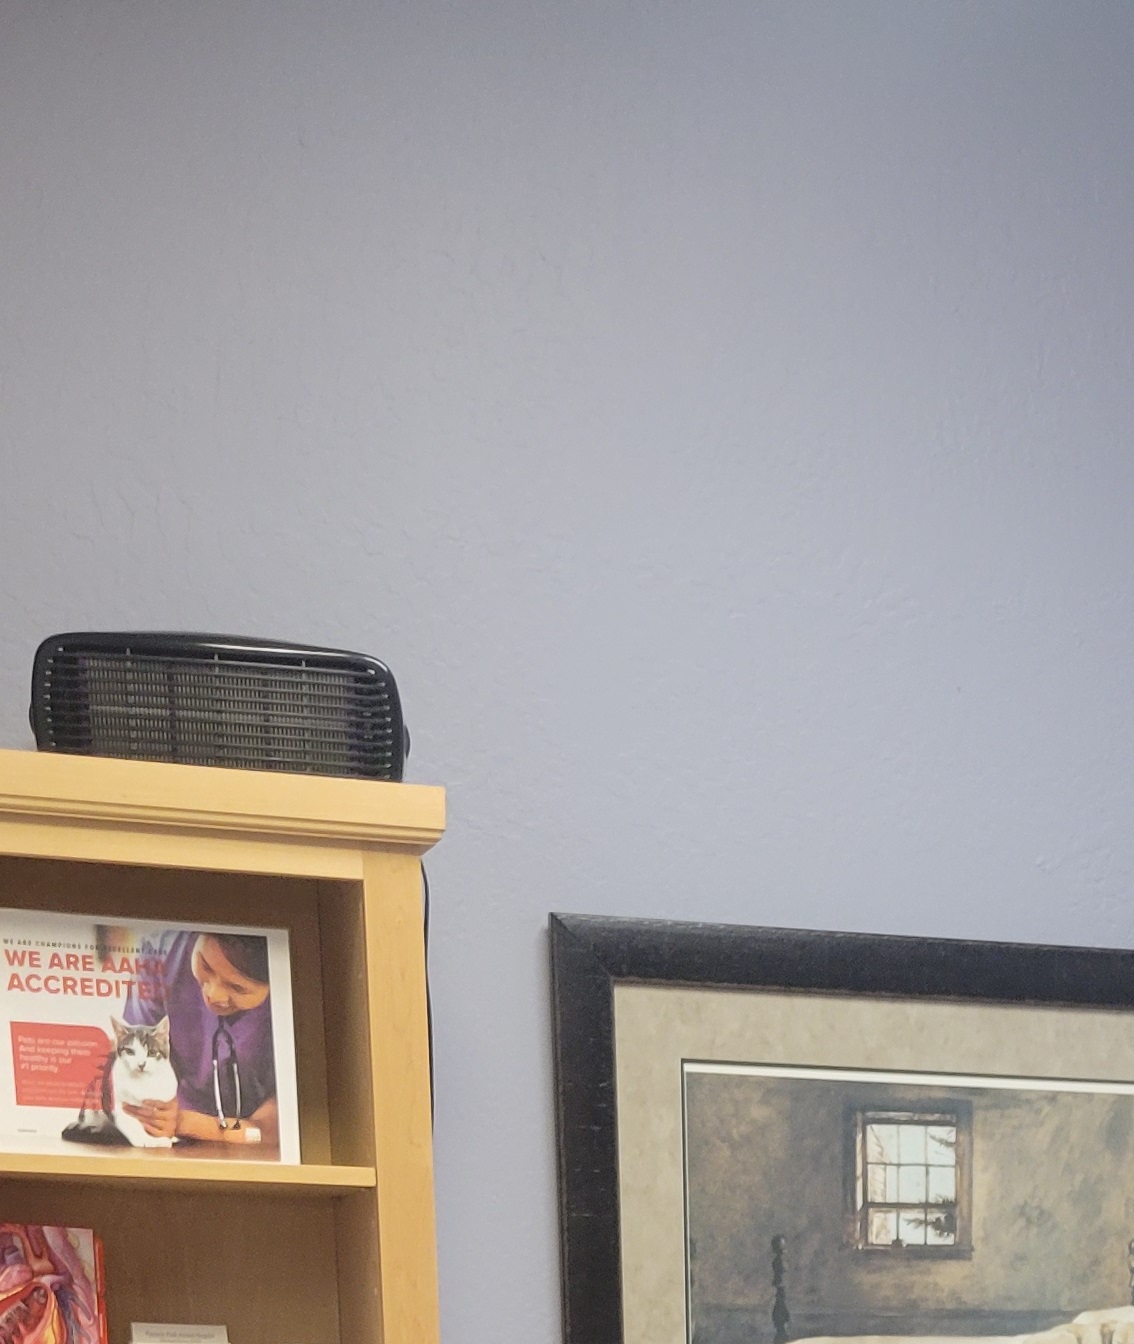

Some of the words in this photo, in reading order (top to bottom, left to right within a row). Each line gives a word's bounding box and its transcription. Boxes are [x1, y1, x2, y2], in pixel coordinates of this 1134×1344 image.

[4, 949, 42, 968] WE
[48, 952, 95, 972] ARE
[101, 955, 167, 977] AAHA
